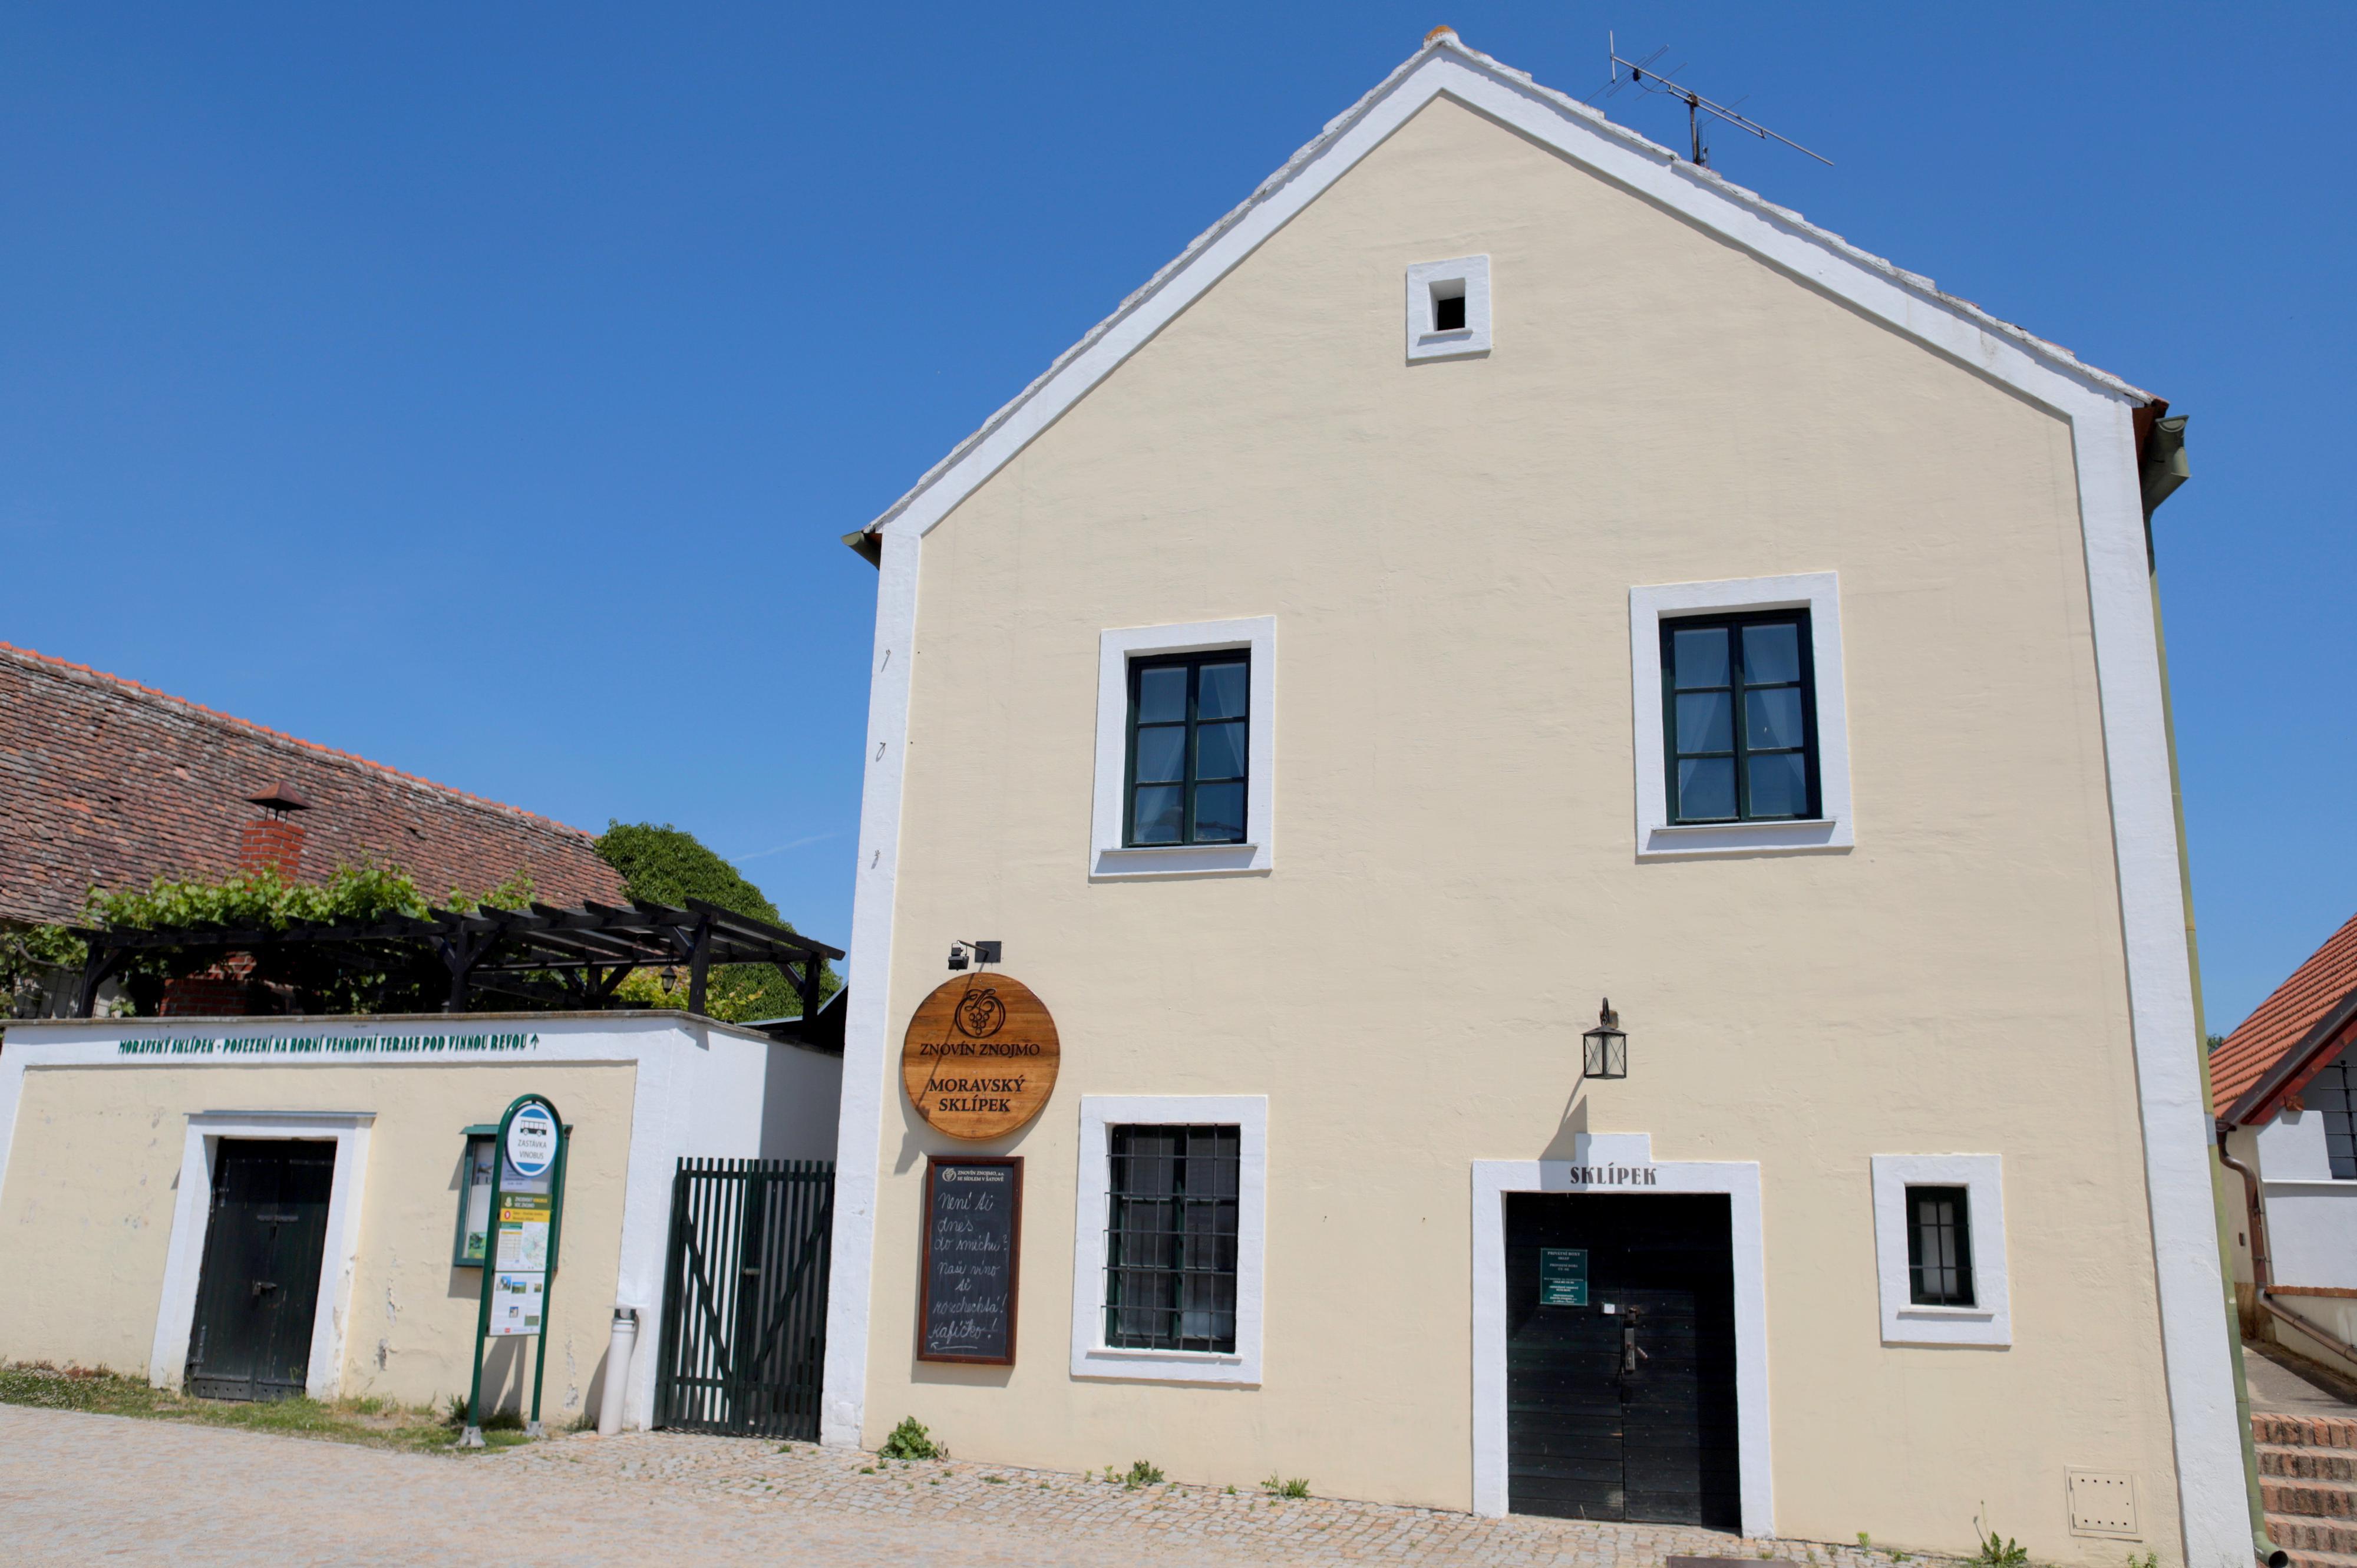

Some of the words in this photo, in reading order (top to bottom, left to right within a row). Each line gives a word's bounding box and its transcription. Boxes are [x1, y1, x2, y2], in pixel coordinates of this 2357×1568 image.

[118, 1036, 171, 1054] MORAVSKÝ
[171, 1035, 215, 1054] SKLÍPEK
[223, 1035, 274, 1054] POSEZENÍ
[274, 1038, 287, 1053] NA
[290, 1034, 325, 1053] HORNÍ
[325, 1034, 379, 1053] VENKOVNÍ
[381, 1036, 420, 1053] TERASE
[422, 1036, 445, 1052] POD
[448, 1035, 488, 1052] VINNOU
[490, 1034, 527, 1052] REVOU
[920, 1041, 976, 1056] ZNOVÍN
[979, 1044, 1040, 1058] ZNOJMO
[929, 1075, 1025, 1092] MORAVSKÝ
[939, 1094, 1011, 1112] SKLÍPEK
[518, 1139, 547, 1148] ZASTÁVKA
[519, 1151, 544, 1160] VINOBUS
[1570, 1162, 1656, 1185] SKLÍPEK
[937, 1217, 973, 1232] dnes
[934, 1237, 953, 1252] do
[970, 1260, 1001, 1276] víno
